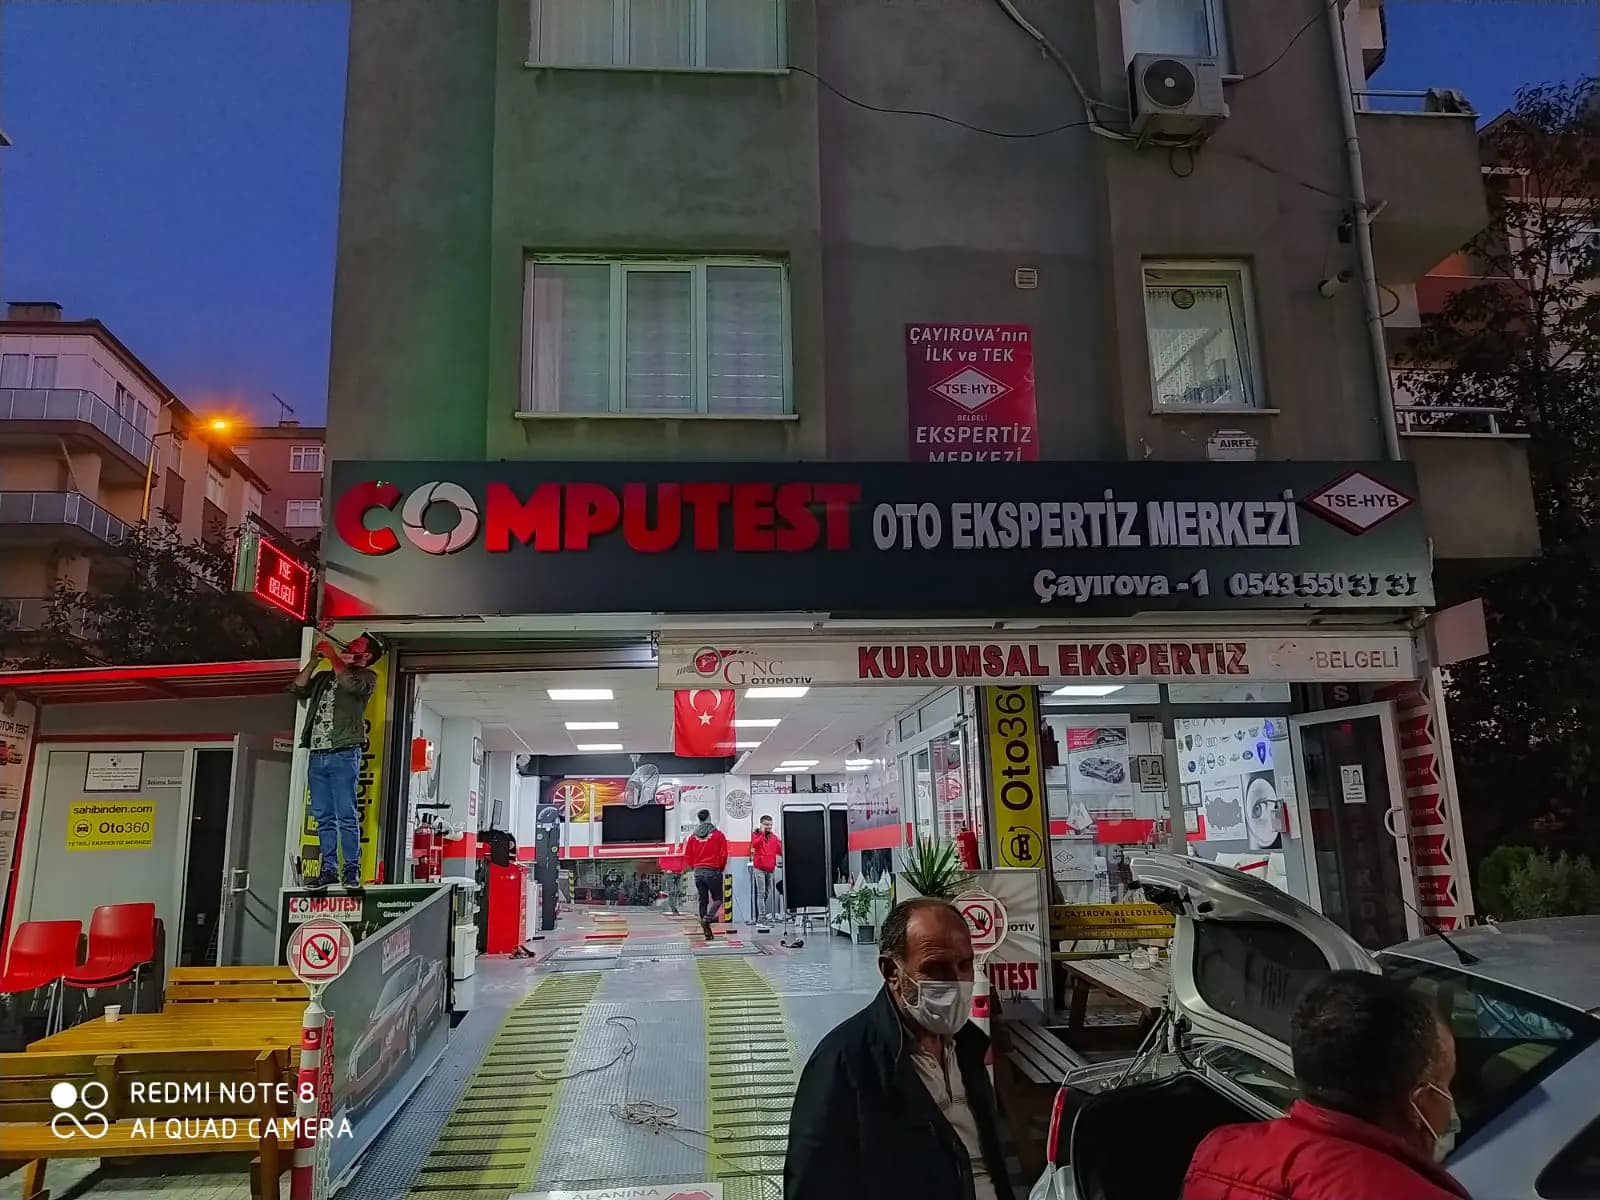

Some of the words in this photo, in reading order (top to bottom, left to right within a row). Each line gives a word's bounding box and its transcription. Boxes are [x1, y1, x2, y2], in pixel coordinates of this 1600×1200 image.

[910, 327, 1028, 344] ÇAYIROVA'nın
[926, 345, 953, 362] İLK
[958, 351, 977, 362] ve
[982, 348, 1014, 362] TEK
[944, 383, 999, 395] TSE-HYB
[916, 423, 1032, 443] EKSPERTİZ
[1324, 493, 1399, 508] TSE-HYB
[333, 480, 862, 556] COMPUTEST
[872, 502, 942, 550] OTO
[951, 489, 1141, 549] EKSPERTİZ
[1146, 488, 1301, 547] MERKEZİ
[1033, 569, 1170, 603] Çayırova
[1229, 572, 1295, 597] 0543
[1301, 572, 1346, 595] 550
[858, 644, 1050, 679] KURUMSAL
[1058, 643, 1249, 676] EKSPERTİZ
[1315, 646, 1399, 669] BELGELİ
[751, 676, 812, 685] OTOMOTİV
[16, 722, 30, 736] TEST
[73, 805, 153, 814] sahibinden.com
[99, 822, 150, 834] Oto360
[289, 897, 361, 913] COMPUTEST
